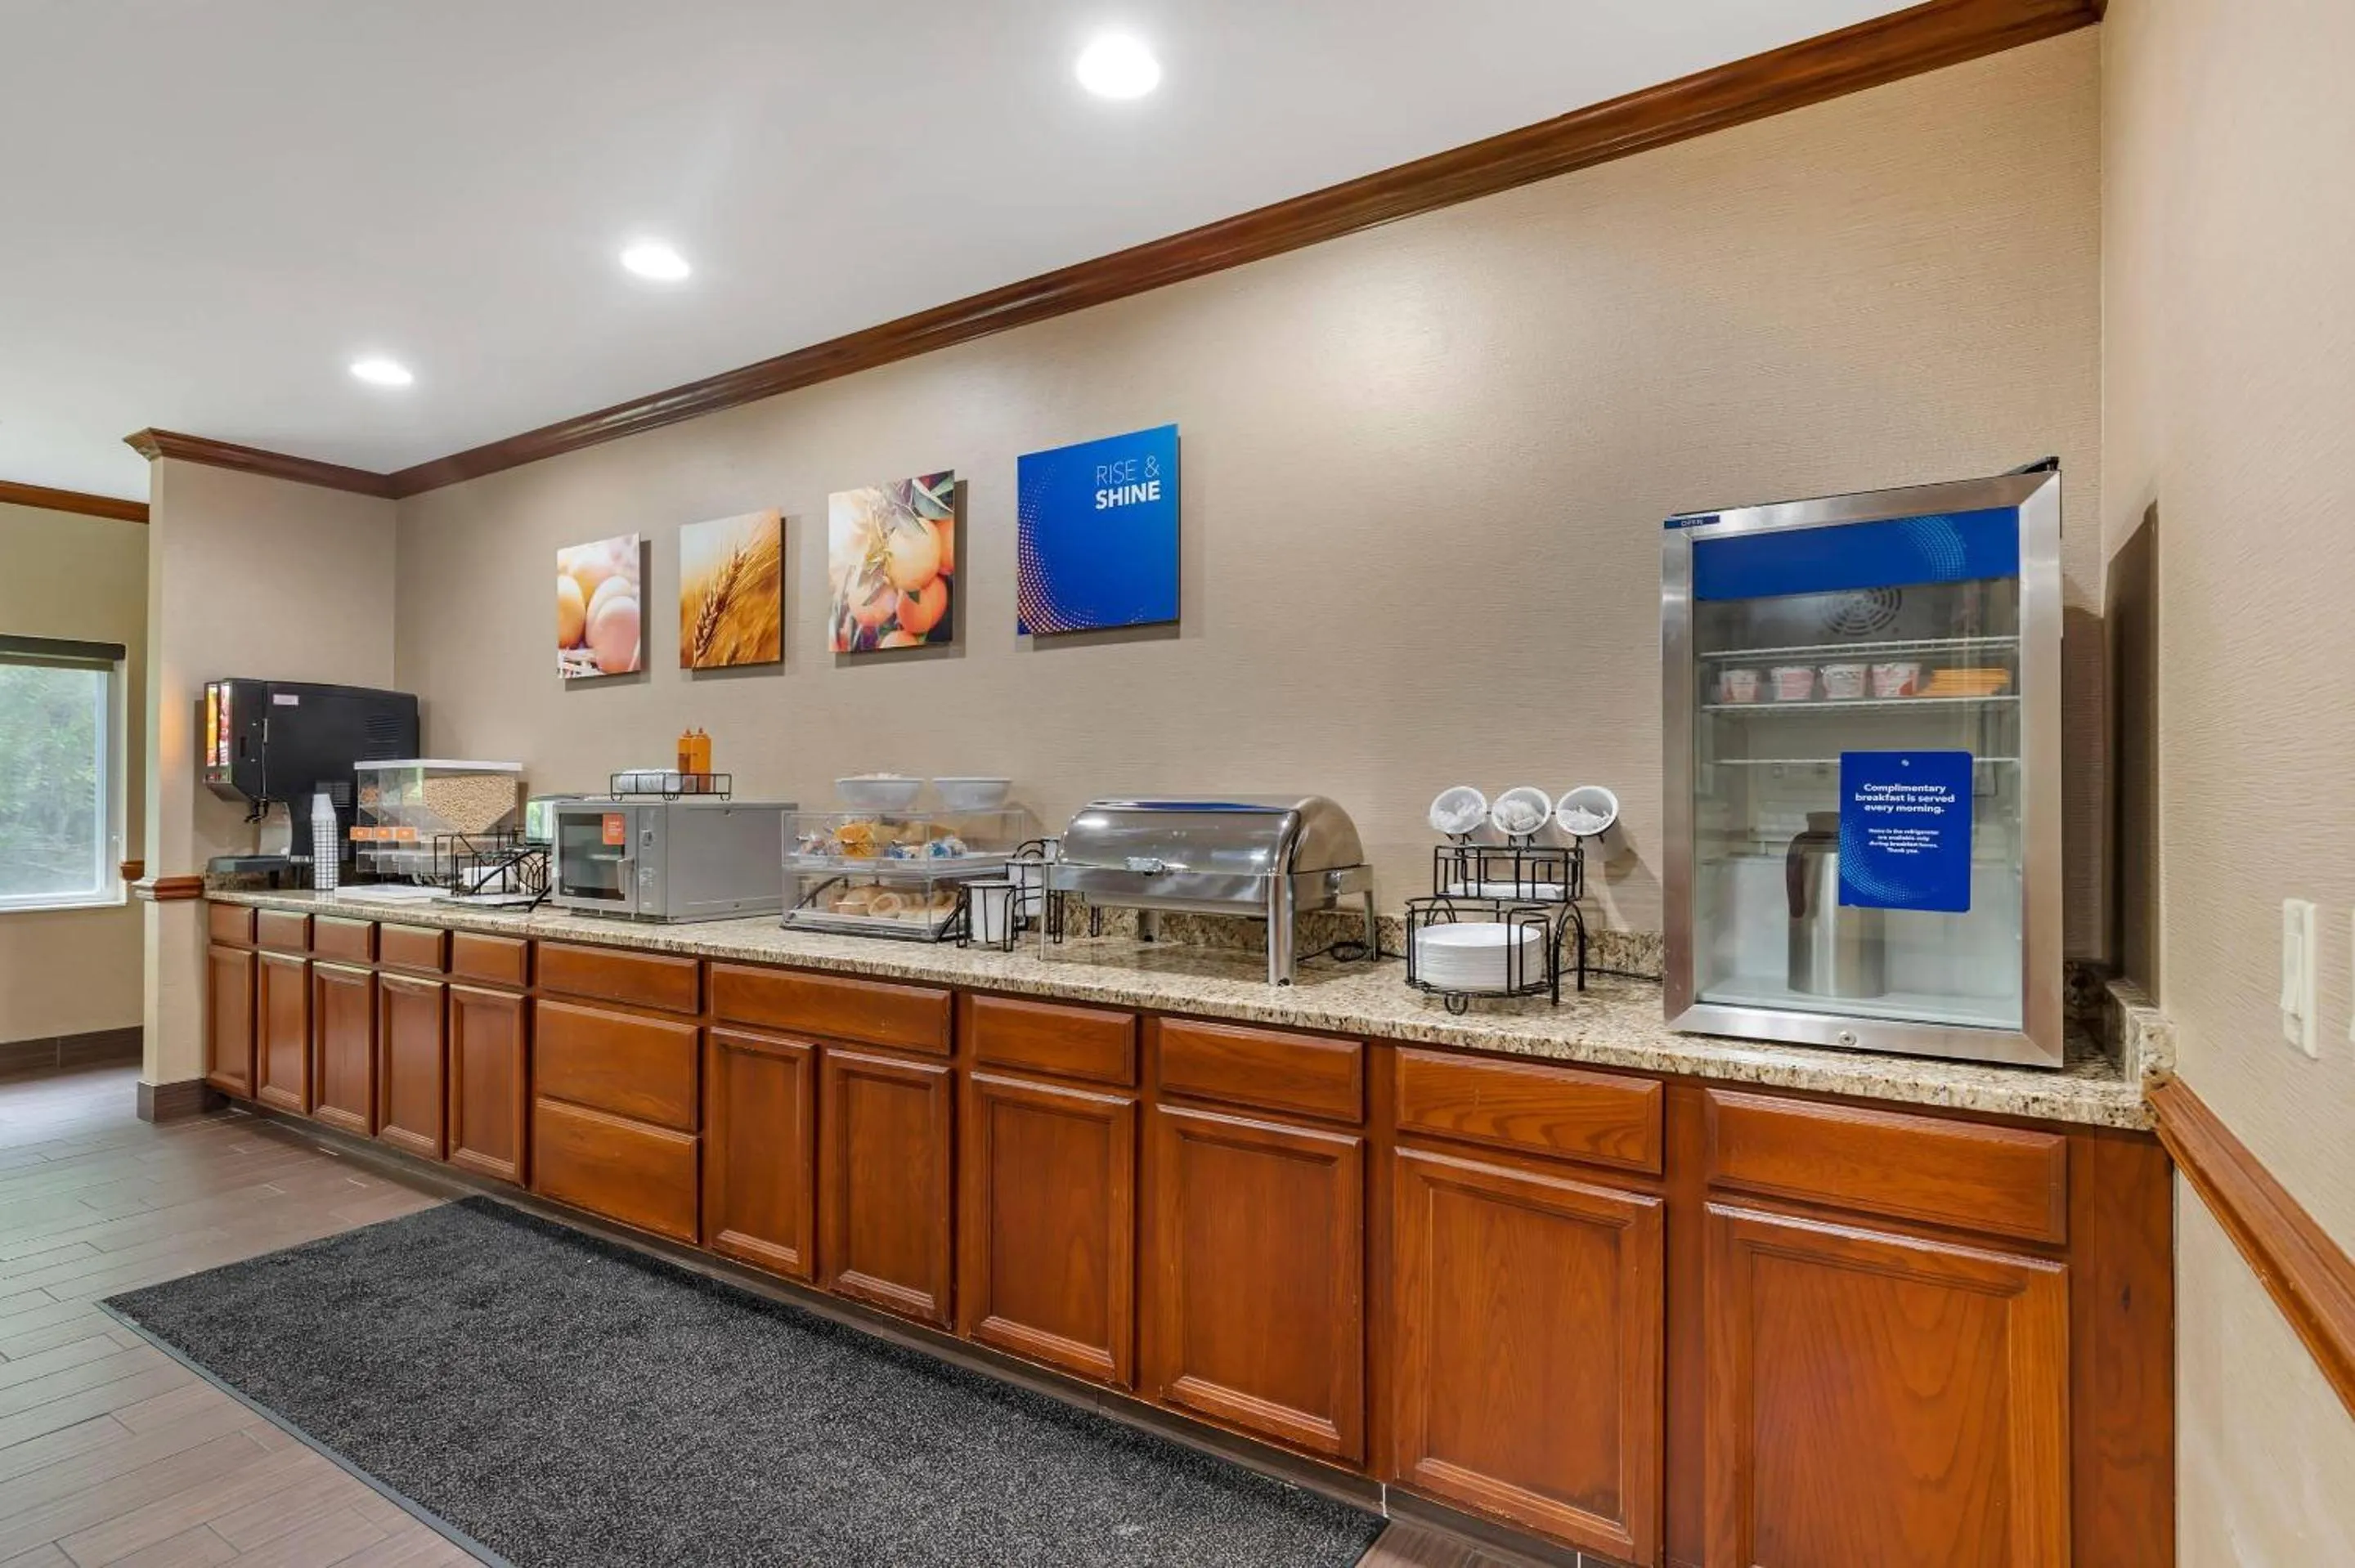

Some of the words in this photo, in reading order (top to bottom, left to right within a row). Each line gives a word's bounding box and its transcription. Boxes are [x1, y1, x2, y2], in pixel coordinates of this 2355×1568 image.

[1097, 459, 1137, 486] RISE
[1145, 455, 1160, 478] &
[1096, 480, 1160, 509] SHINE
[1863, 783, 1947, 795] Complimentary
[1855, 793, 1905, 802] breakfast
[1907, 794, 1916, 803] is
[1918, 794, 1956, 803] served
[1864, 804, 1894, 813] every
[1895, 804, 1945, 815] morning.
